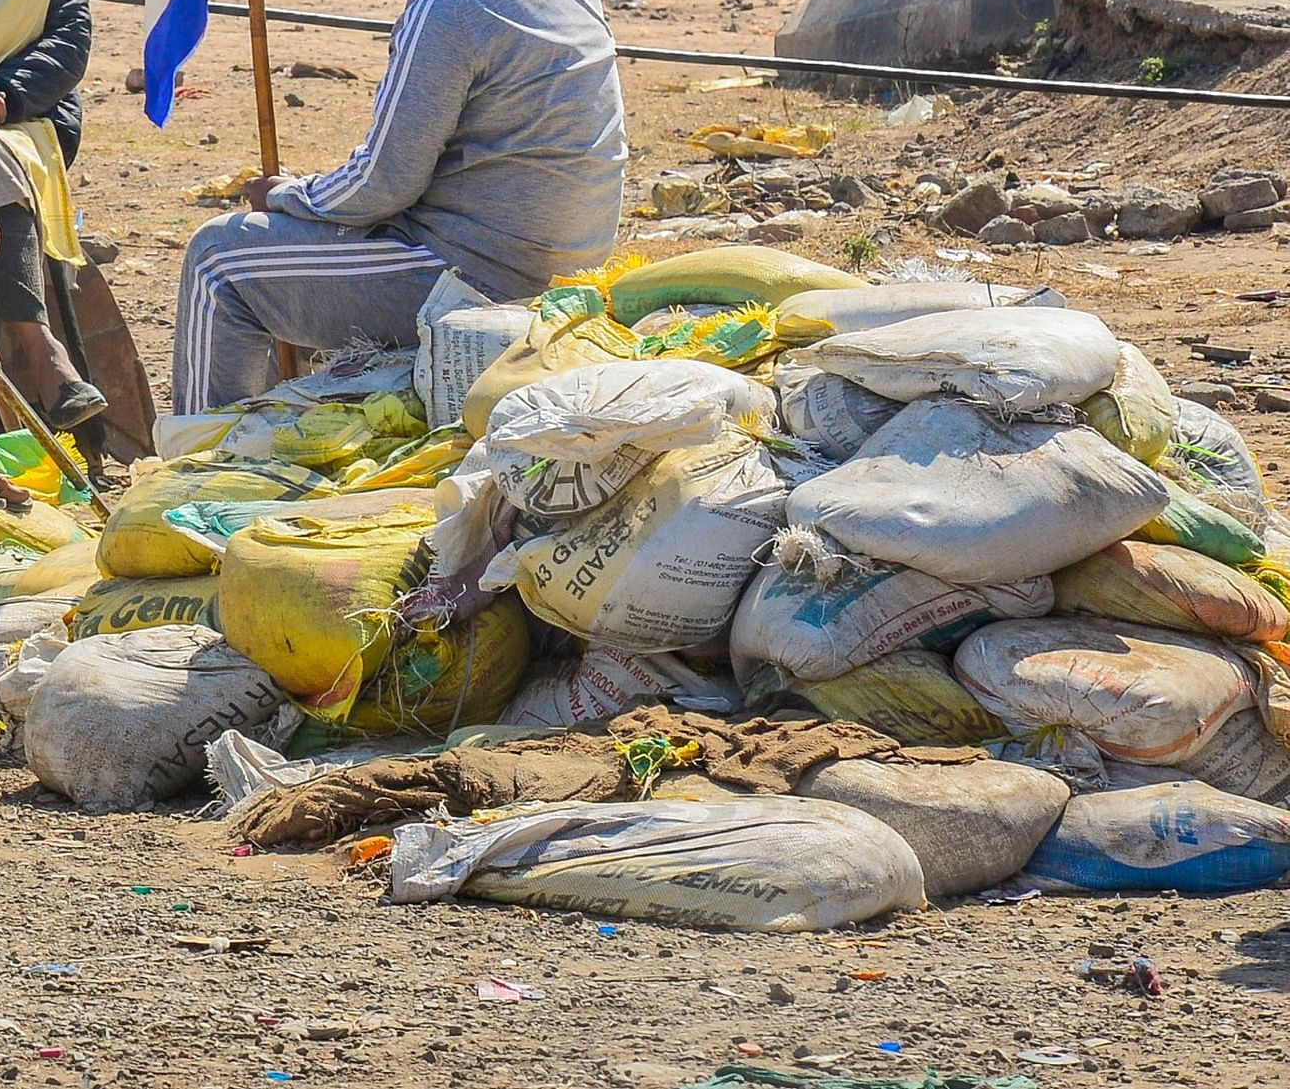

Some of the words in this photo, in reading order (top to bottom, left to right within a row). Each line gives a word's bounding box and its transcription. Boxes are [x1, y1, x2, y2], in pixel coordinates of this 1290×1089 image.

[709, 508, 738, 521] SHREE
[886, 628, 904, 643] For
[937, 598, 972, 617] Sales
[630, 664, 654, 687] RAW
[668, 872, 788, 903] CEMENT
